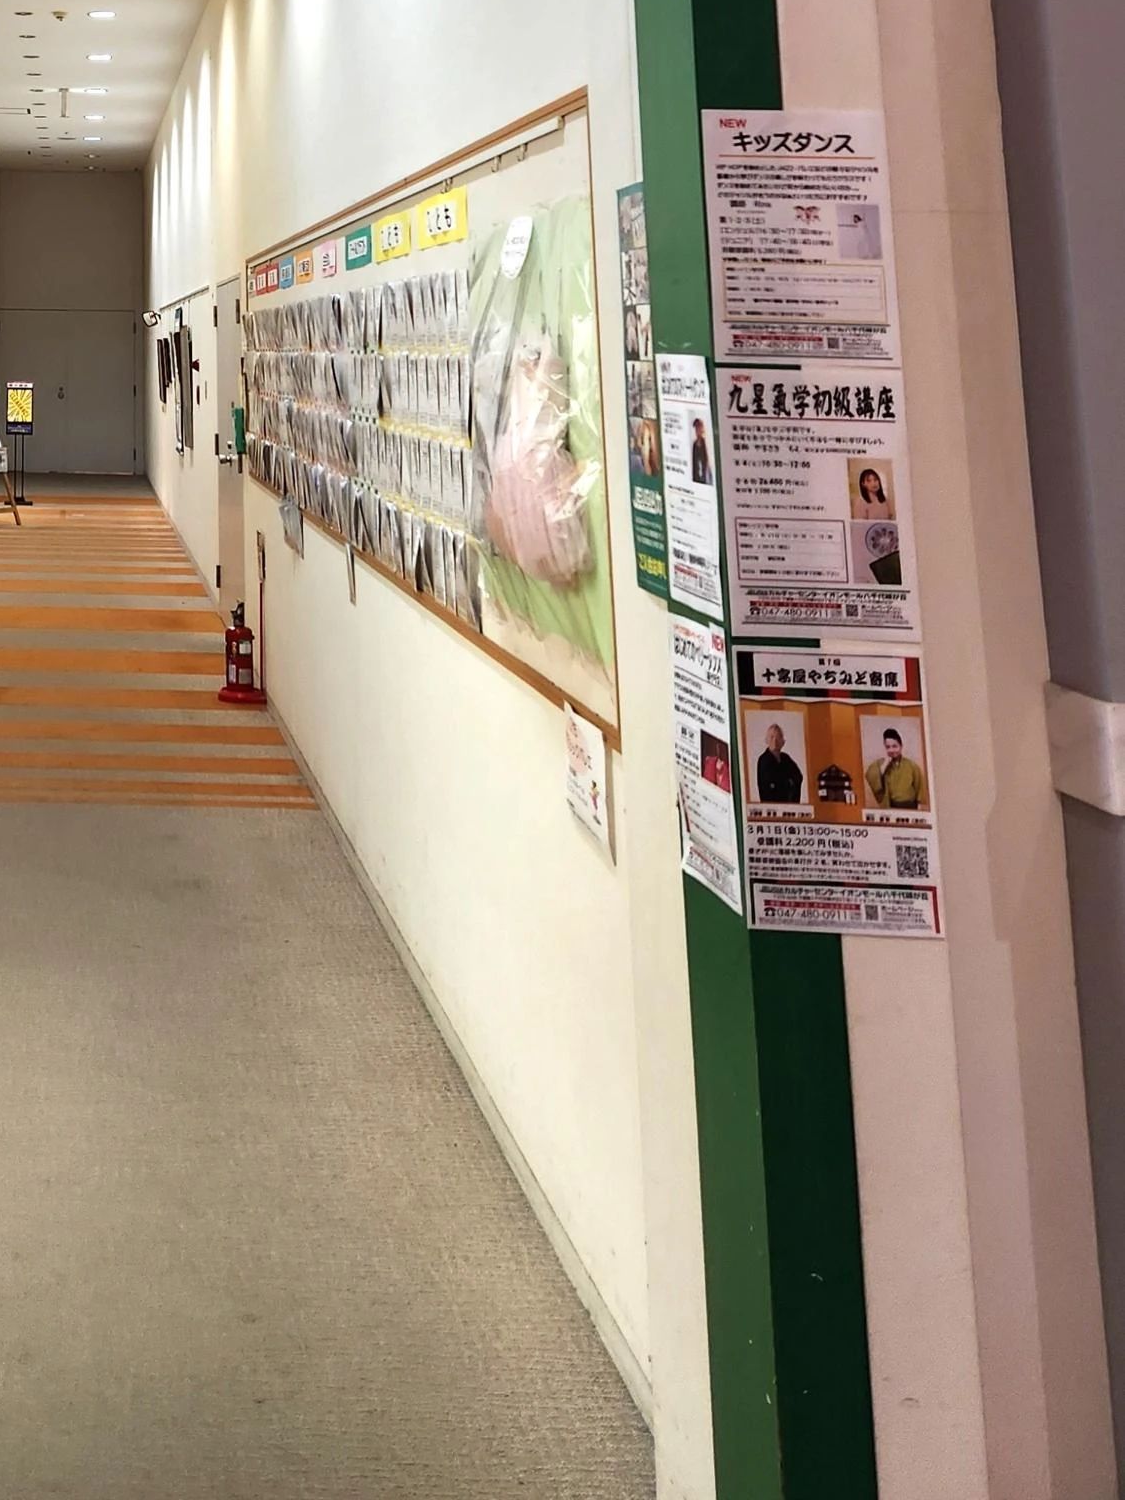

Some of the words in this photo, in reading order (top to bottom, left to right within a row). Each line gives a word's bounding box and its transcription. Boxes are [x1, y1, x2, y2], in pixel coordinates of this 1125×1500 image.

[720, 119, 746, 127] NEW
[733, 132, 854, 153] キッズダンス
[728, 383, 895, 418] 九星氣学初級講座
